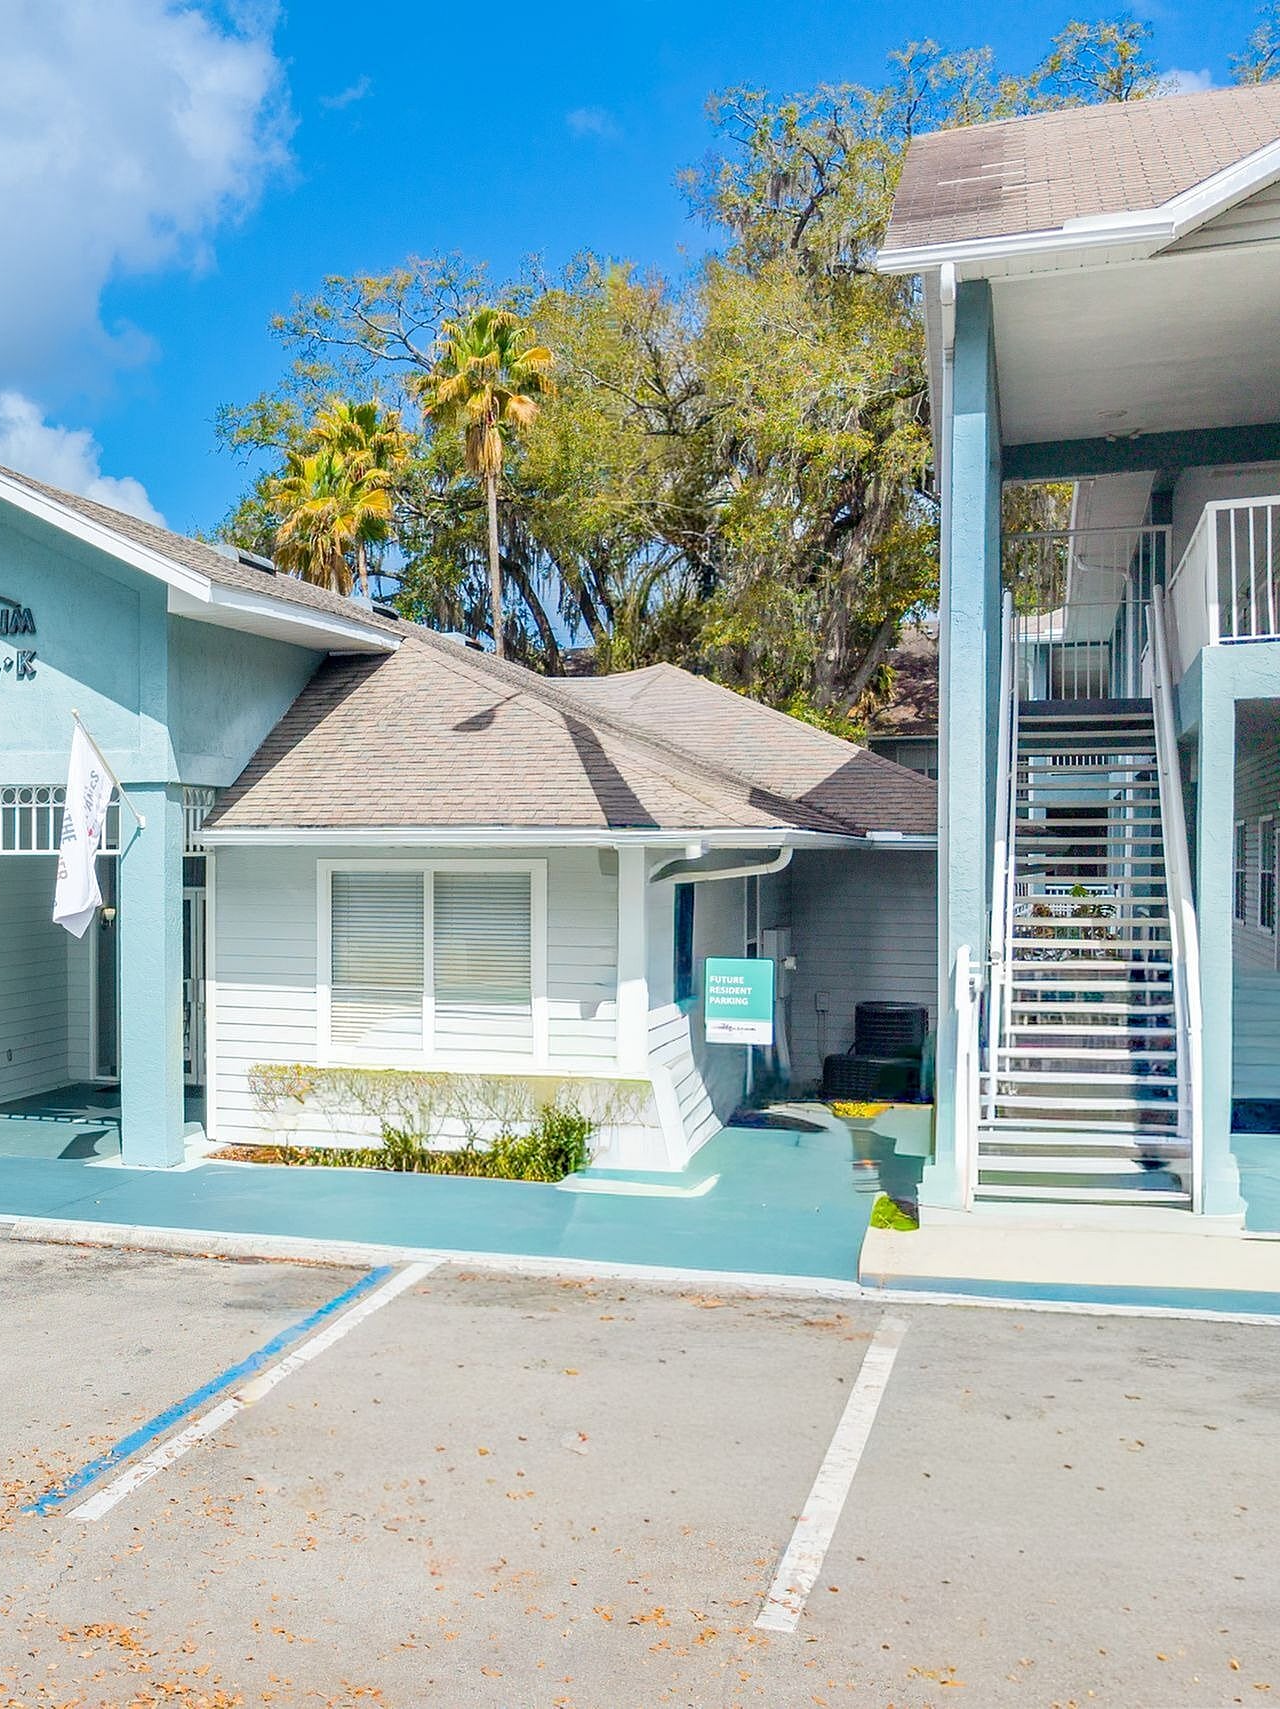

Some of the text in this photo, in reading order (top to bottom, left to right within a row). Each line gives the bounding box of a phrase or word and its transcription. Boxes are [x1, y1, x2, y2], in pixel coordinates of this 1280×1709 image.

[709, 975, 745, 985] FUTURE
[709, 986, 753, 995] RESIDENT
[709, 996, 749, 1006] PARKING
